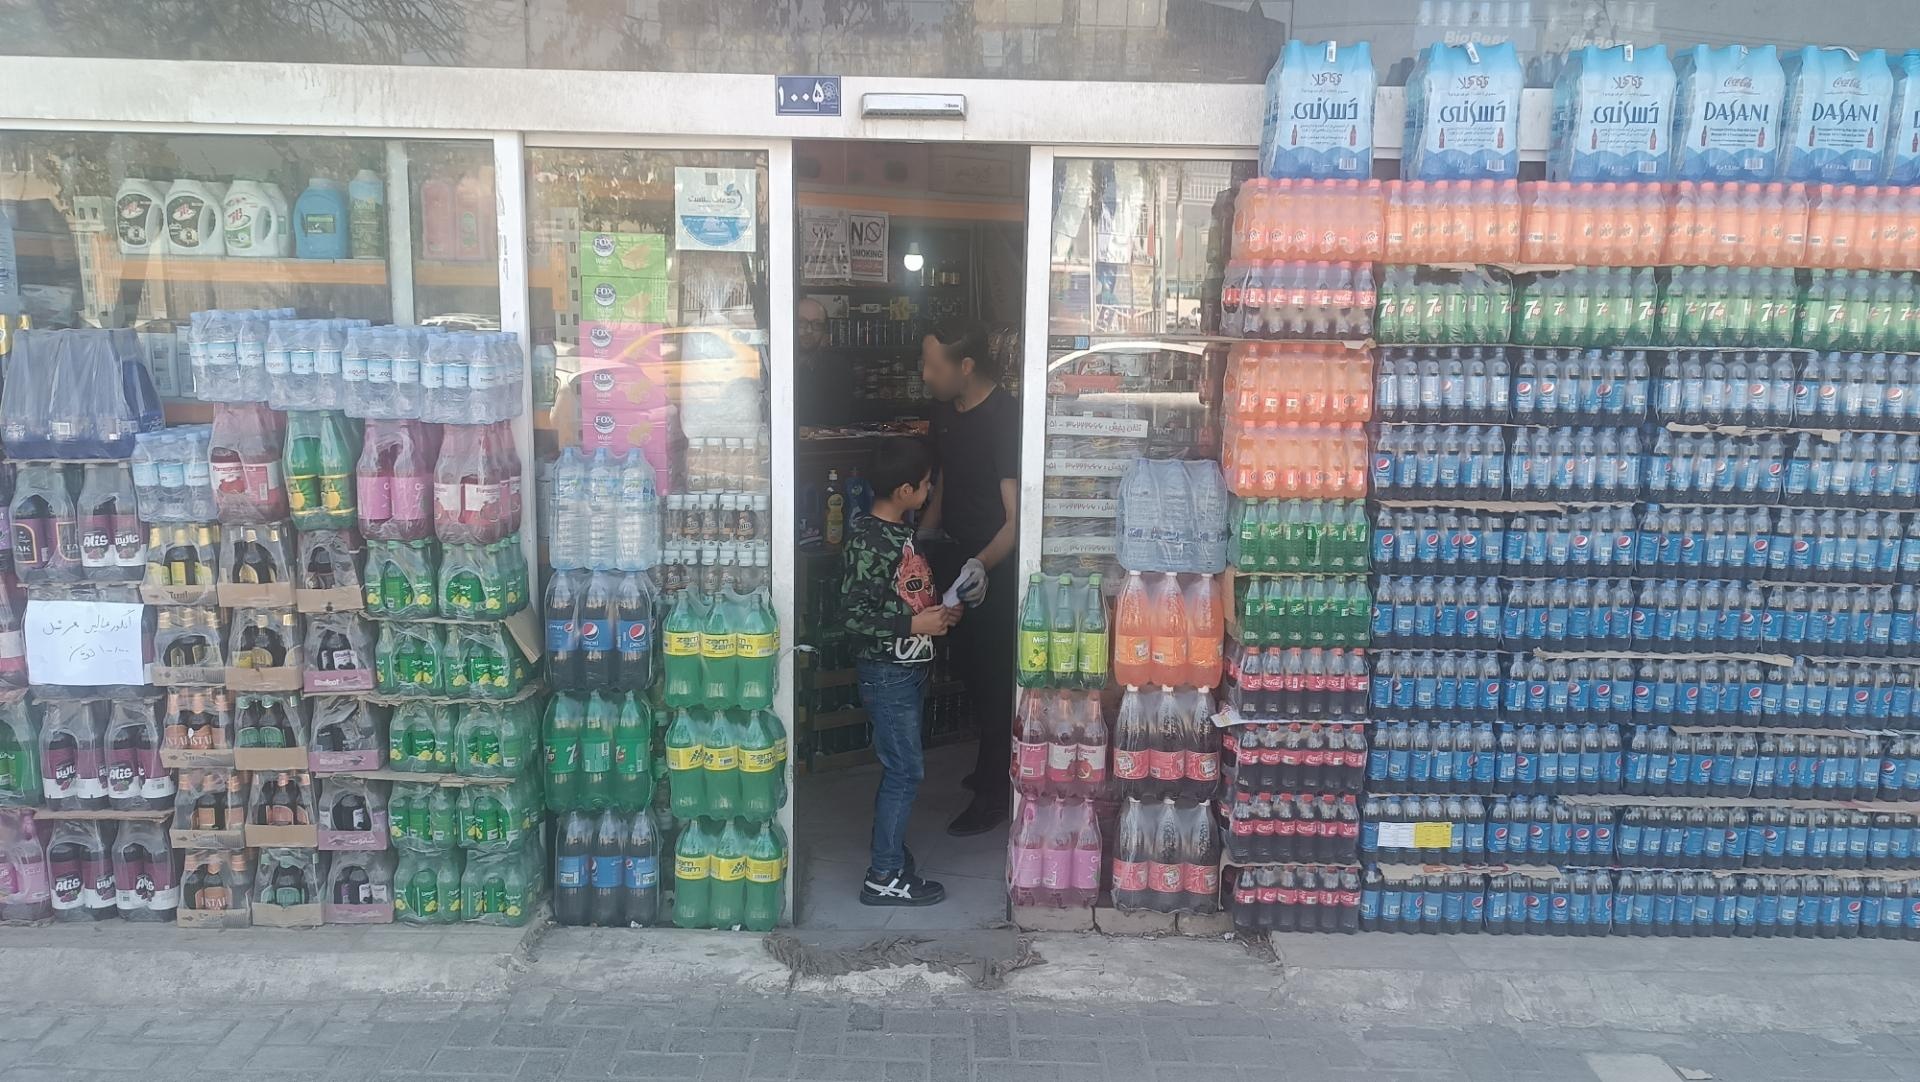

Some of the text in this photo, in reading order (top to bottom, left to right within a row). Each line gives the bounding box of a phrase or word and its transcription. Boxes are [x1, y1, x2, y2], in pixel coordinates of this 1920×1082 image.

[778, 79, 825, 107] ۱۰۰۵
[1703, 99, 1769, 125] DASANI
[1812, 99, 1878, 125] DASANI
[594, 238, 613, 247] FOX
[852, 249, 883, 258] SMOKING
[595, 287, 614, 296] FOX
[591, 328, 609, 337] FOX
[593, 373, 612, 382] FOX
[595, 415, 614, 424] FOX
[750, 752, 773, 760] zam
[679, 864, 701, 873] zam
